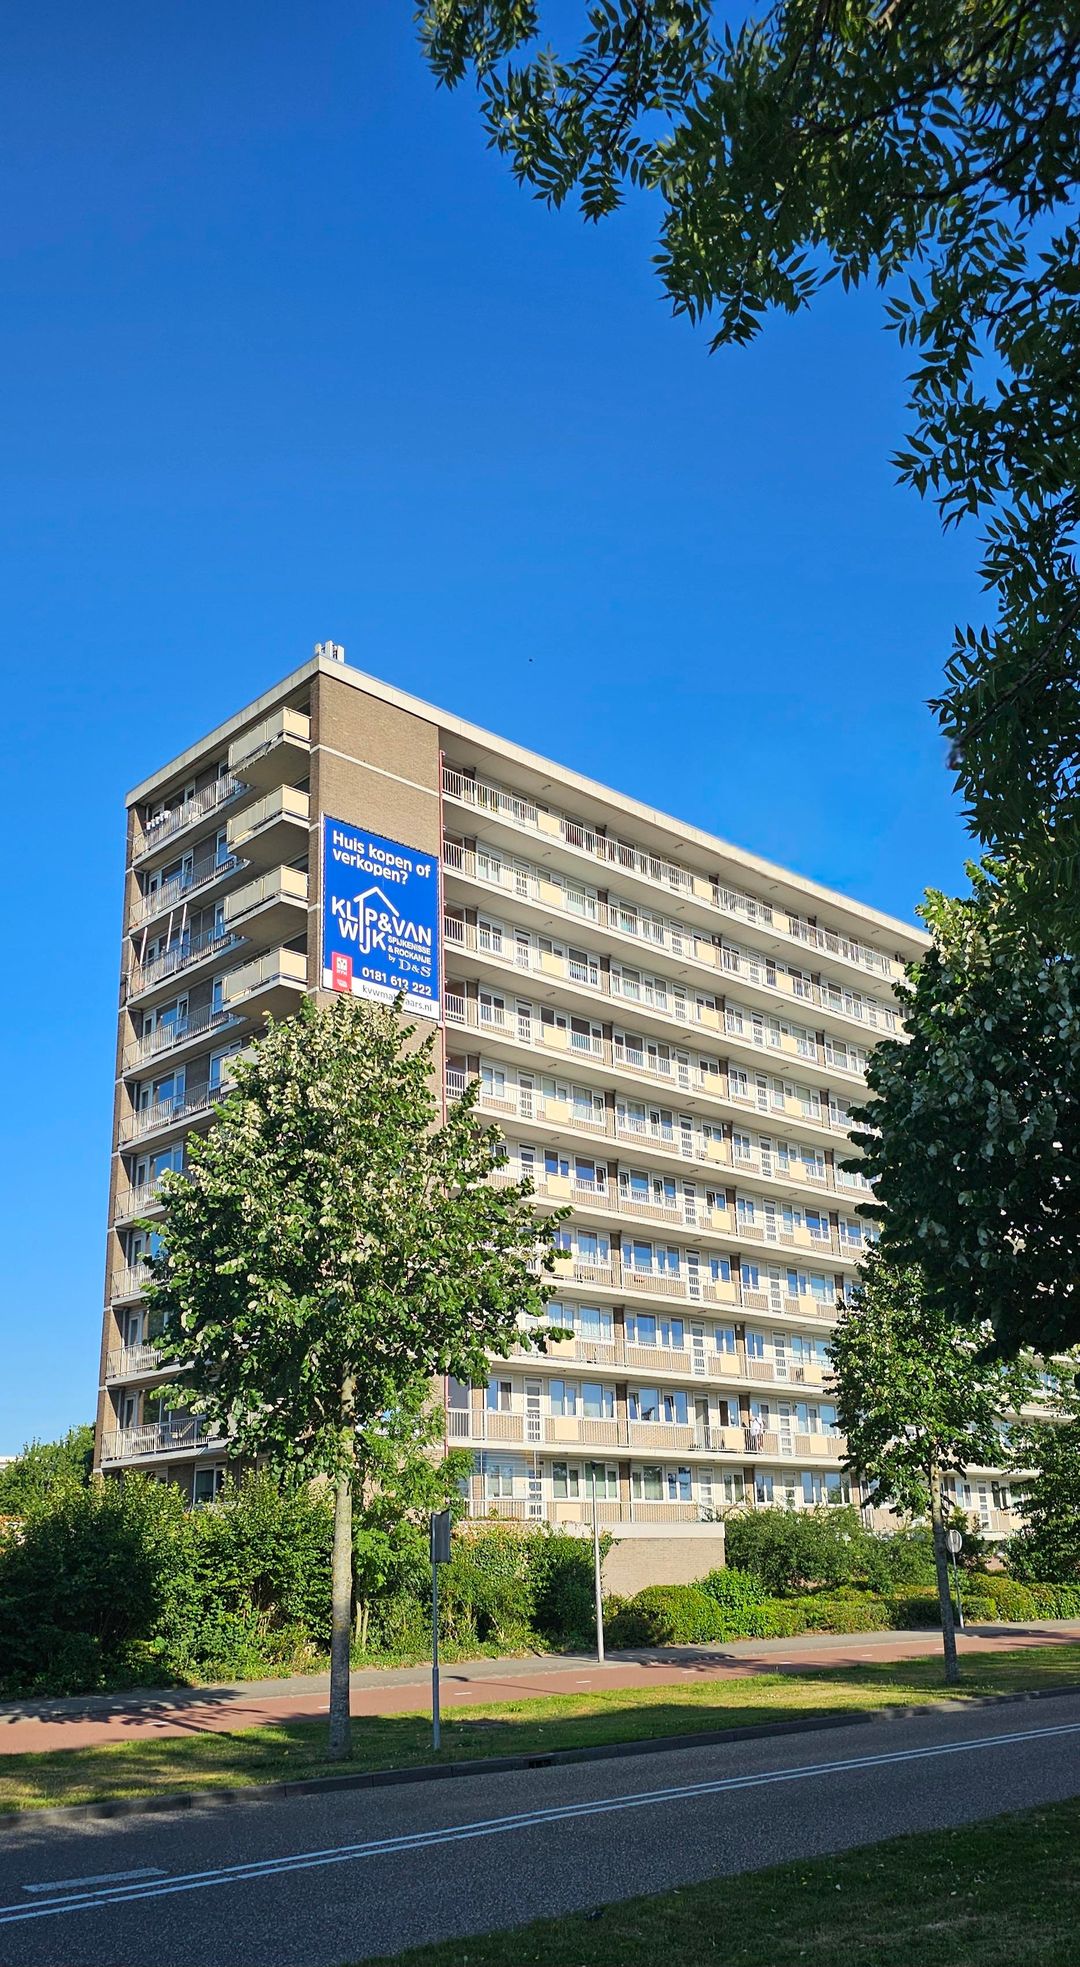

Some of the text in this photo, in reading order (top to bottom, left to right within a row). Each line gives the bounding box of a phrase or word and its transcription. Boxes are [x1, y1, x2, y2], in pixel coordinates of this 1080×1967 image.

[333, 830, 431, 878] Huis kopen of
[333, 848, 408, 885] verkopen?
[387, 935, 431, 955] SPIJKENISSE
[394, 946, 432, 965] ROCKANJE
[388, 954, 396, 963] by
[362, 967, 387, 983] 0181
[390, 975, 409, 990] 612
[412, 982, 432, 996] 222
